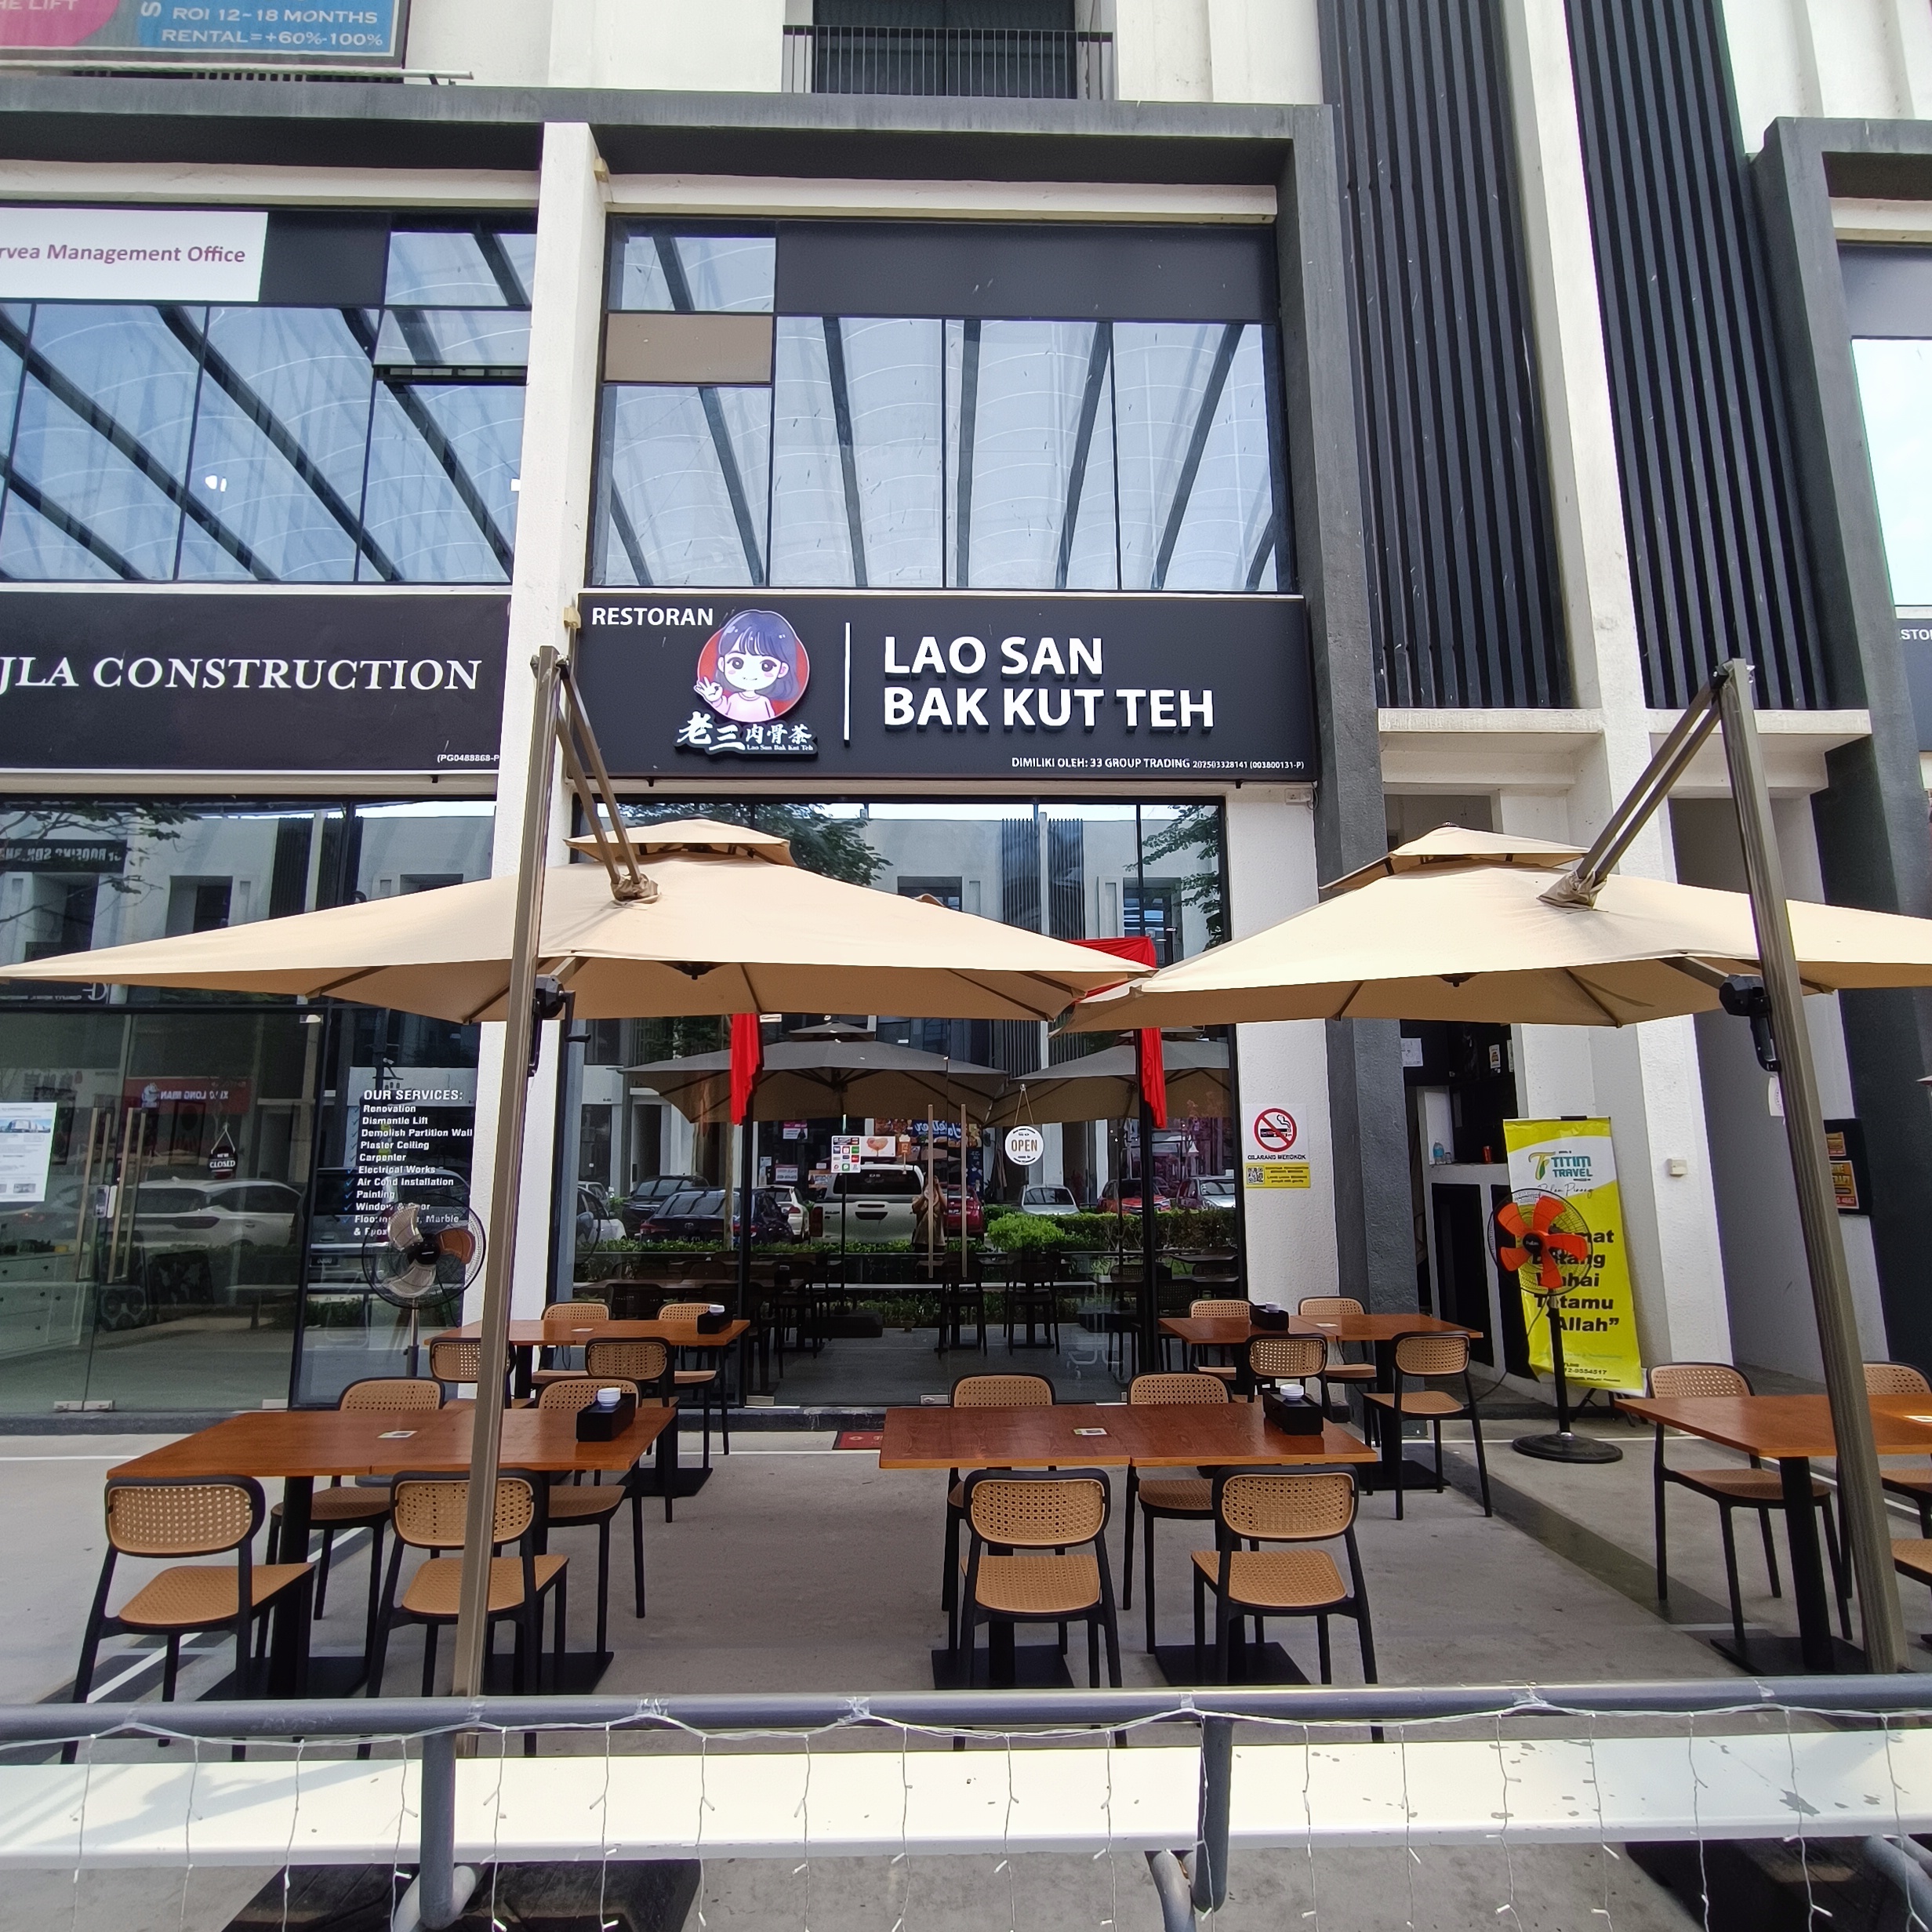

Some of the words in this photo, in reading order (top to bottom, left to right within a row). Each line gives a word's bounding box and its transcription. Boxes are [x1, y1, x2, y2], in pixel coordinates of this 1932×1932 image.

[172, 8, 210, 20] ROI
[284, 10, 378, 24] MONTHS
[47, 245, 181, 264] Management
[187, 245, 245, 263] Office
[591, 607, 714, 626] RESTORAN
[884, 636, 987, 676] LAO
[1000, 637, 1103, 677] SAN
[93, 656, 482, 690] CONSTRUCTION
[884, 687, 990, 728] BAK
[1004, 688, 1105, 728] KUT
[1115, 689, 1215, 729] TEH
[1011, 757, 1055, 768] DIMILIKI
[1057, 757, 1088, 768] OLEH:
[1090, 758, 1102, 768] 33
[1104, 758, 1142, 768] GROUP
[1143, 758, 1190, 768] TRADING
[364, 1090, 391, 1100] OUR
[395, 1090, 463, 1100] SERVICES:
[362, 1117, 410, 1125] Dismantle
[361, 1128, 405, 1137] Demolish
[409, 1128, 448, 1137] Partition
[452, 1128, 473, 1137] Wall
[360, 1141, 394, 1149] Plaster
[397, 1141, 430, 1150] Ceiling
[1011, 1139, 1037, 1152] OPEN
[359, 1153, 407, 1163] Carpenter
[1551, 1156, 1592, 1168] TITIM
[358, 1166, 403, 1175] Electrical
[406, 1166, 436, 1175] Works
[1552, 1168, 1593, 1178] TRAVEL
[357, 1178, 370, 1186] Air
[374, 1178, 398, 1186] Cond
[401, 1178, 454, 1186] Installation
[356, 1190, 395, 1200] Painting
[426, 1215, 459, 1223] Marble
[1534, 1295, 1614, 1309] Ttamu
